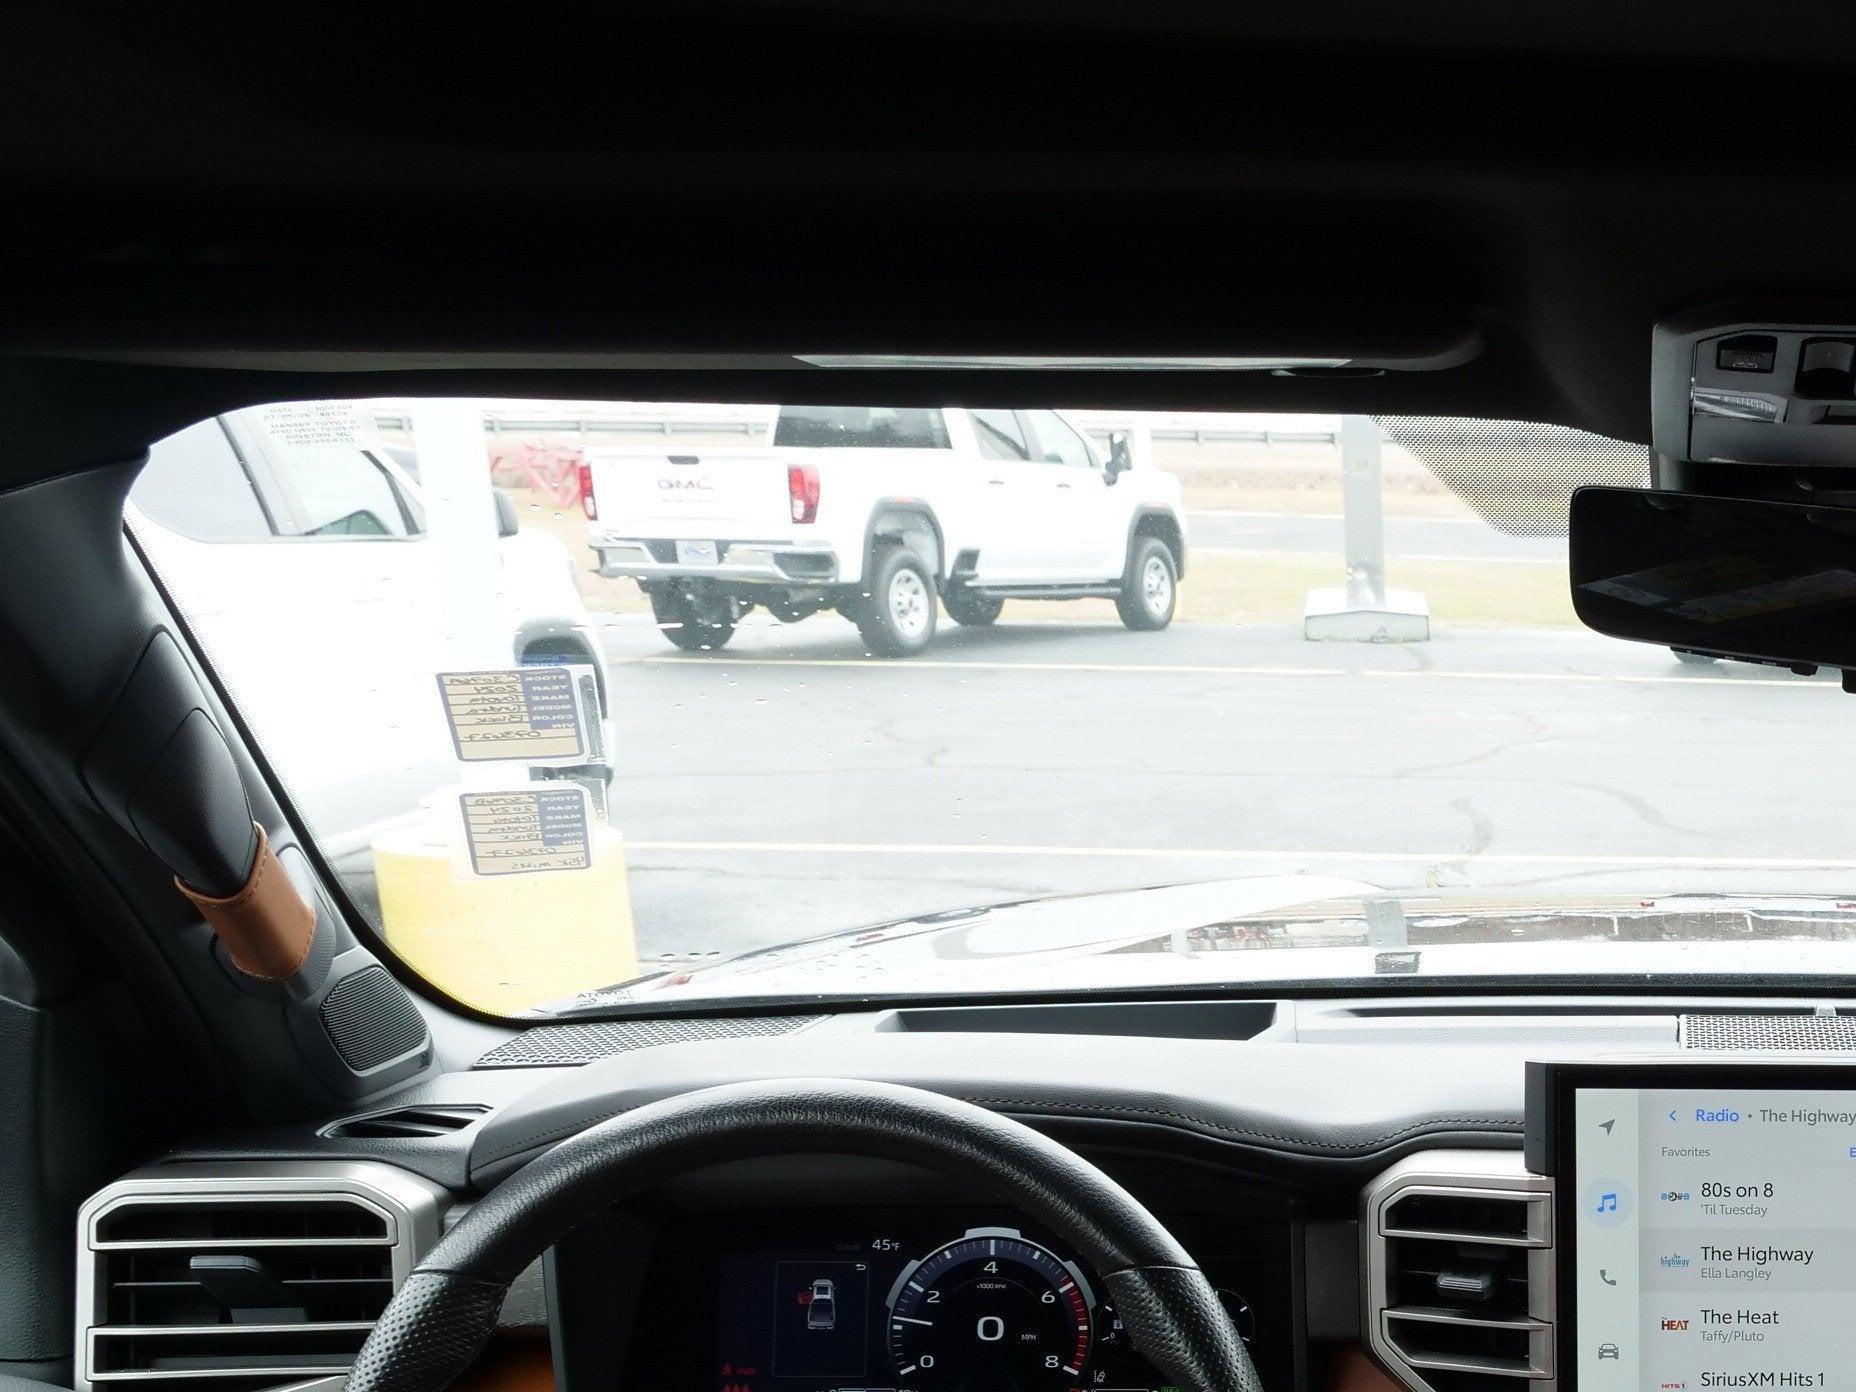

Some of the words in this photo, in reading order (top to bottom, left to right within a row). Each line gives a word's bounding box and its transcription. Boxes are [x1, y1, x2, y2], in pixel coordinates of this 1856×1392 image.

[657, 477, 714, 490] GMC
[1696, 1109, 1740, 1123] Radio
[1760, 1109, 1787, 1123] The
[1791, 1109, 1856, 1126] Highway
[1661, 1147, 1711, 1157] Favorites
[1701, 1182, 1731, 1198] 80s
[1736, 1186, 1758, 1198] on
[1764, 1182, 1774, 1198] 8
[1720, 1204, 1768, 1218] Tuesday
[1701, 1246, 1733, 1261] The
[1737, 1246, 1814, 1265] Highway
[982, 1261, 999, 1274] 4
[1701, 1268, 1722, 1279] Ella
[1725, 1268, 1772, 1281] Langley
[927, 1291, 940, 1304] 2
[1041, 1291, 1055, 1304] 6
[1701, 1309, 1732, 1324] The
[1737, 1309, 1780, 1324] Heat
[976, 1316, 1004, 1341] 0
[1661, 1320, 1690, 1331] HEAT
[1701, 1331, 1765, 1344] Taffy/Pluto
[920, 1356, 934, 1368] 0
[1045, 1356, 1059, 1368] 8
[1700, 1372, 1775, 1387] SiriusXM
[1780, 1372, 1813, 1387] Hits
[1817, 1372, 1825, 1387] 1
